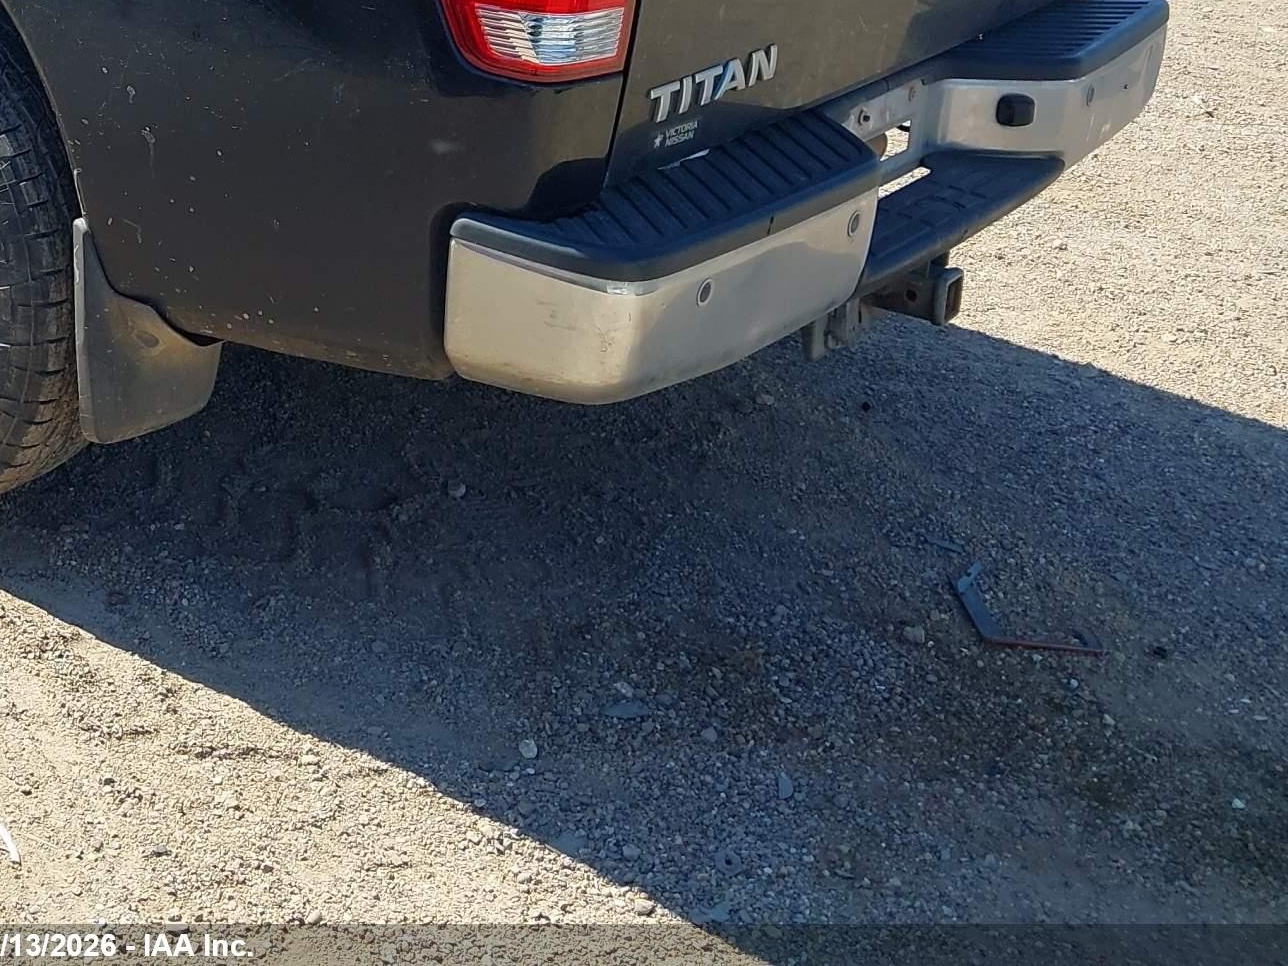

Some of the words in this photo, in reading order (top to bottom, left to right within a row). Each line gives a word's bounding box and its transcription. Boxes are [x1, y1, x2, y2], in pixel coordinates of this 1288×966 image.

[648, 43, 778, 123] TITAN
[665, 121, 698, 139] VICTORIA
[665, 130, 695, 147] NISSAN
